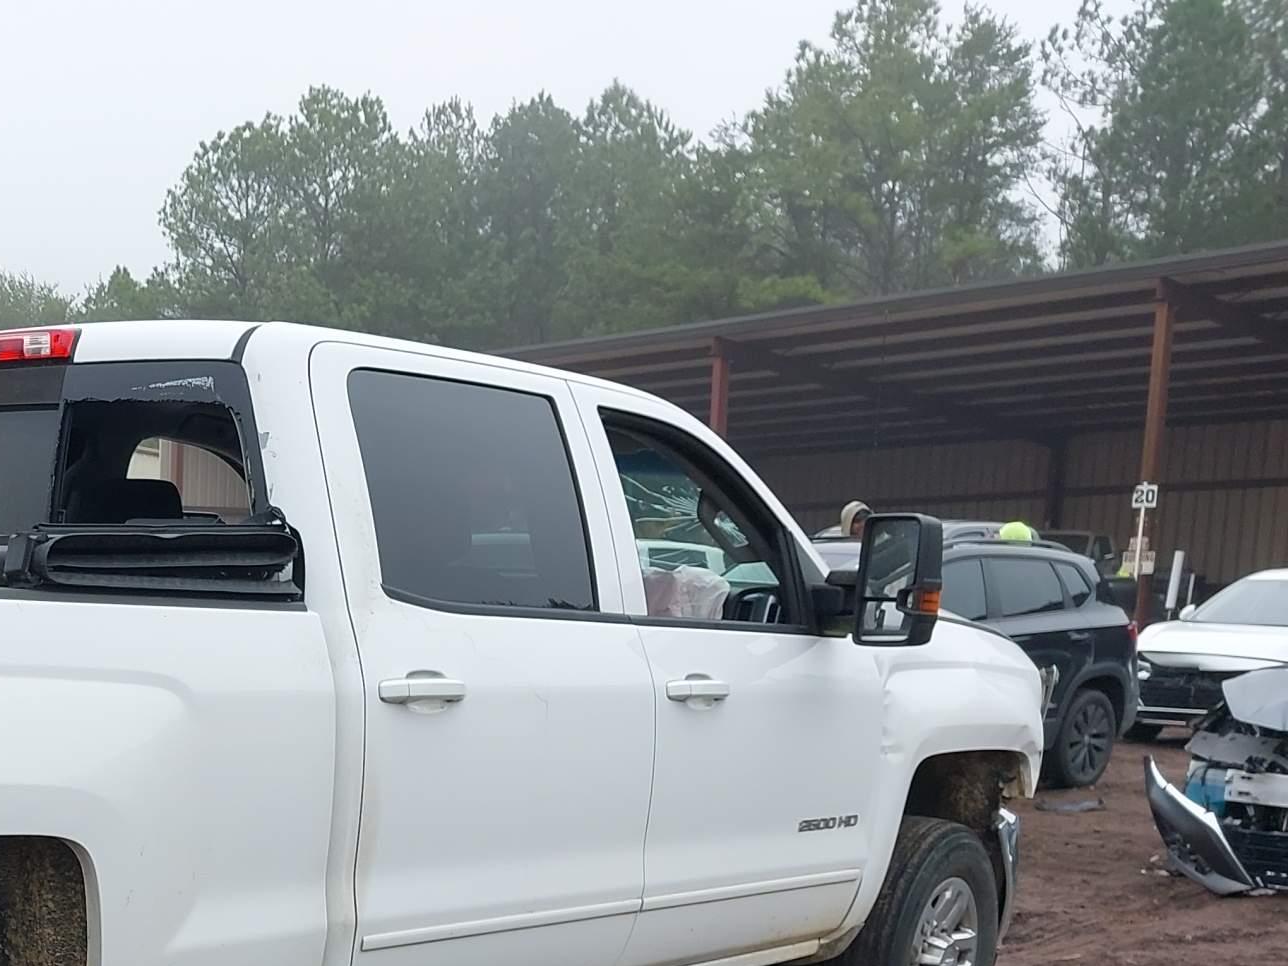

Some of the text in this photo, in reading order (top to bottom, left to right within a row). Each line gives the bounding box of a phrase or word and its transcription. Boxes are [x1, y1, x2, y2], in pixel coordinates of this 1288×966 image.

[1135, 489, 1156, 503] 20
[798, 815, 858, 833] 2500 HD
